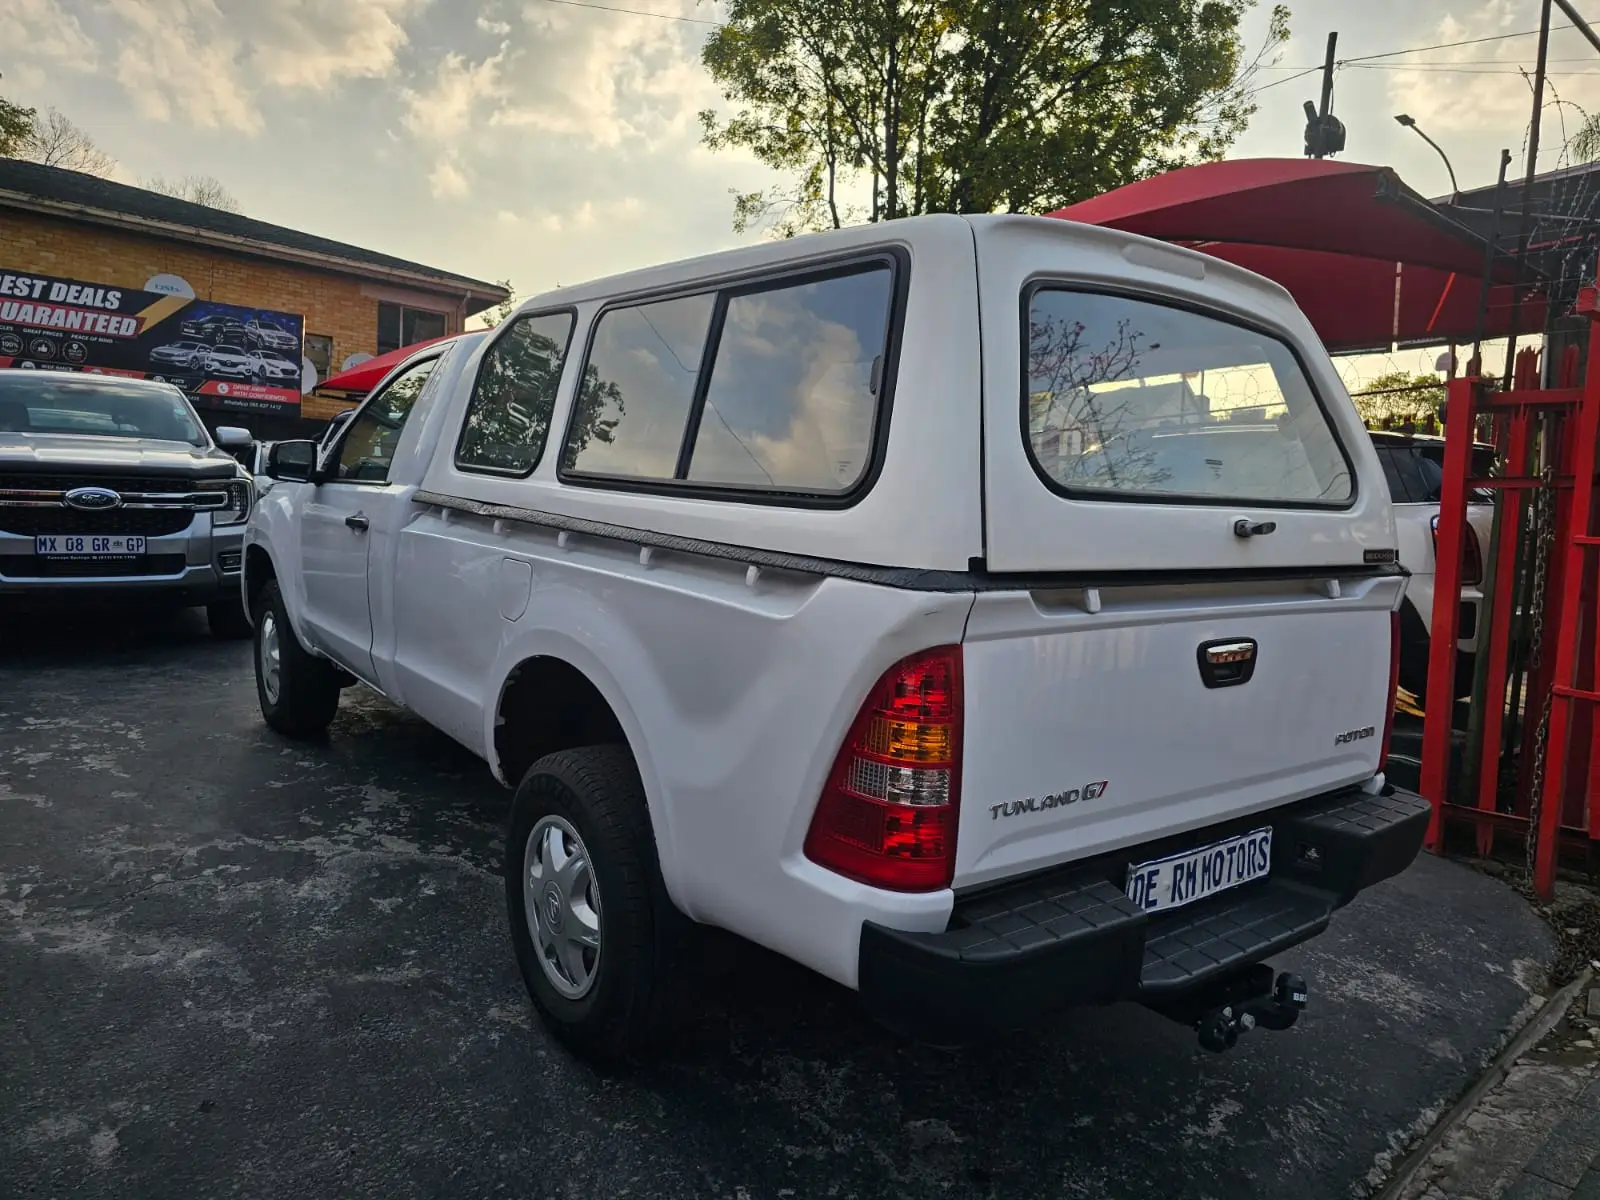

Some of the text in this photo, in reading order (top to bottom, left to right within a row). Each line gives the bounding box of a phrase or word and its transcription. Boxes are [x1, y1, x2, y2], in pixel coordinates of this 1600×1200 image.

[0, 275, 122, 310] EST DEALS
[0, 302, 137, 336] UARANTEED
[42, 330, 63, 338] PRICES
[71, 333, 89, 341] PEACE
[80, 494, 107, 504] Ford
[38, 537, 144, 552] MX 08 GR GP
[989, 780, 1109, 820] TUNLAND G7
[1170, 858, 1198, 903] RM
[1201, 835, 1270, 892] MOTORS
